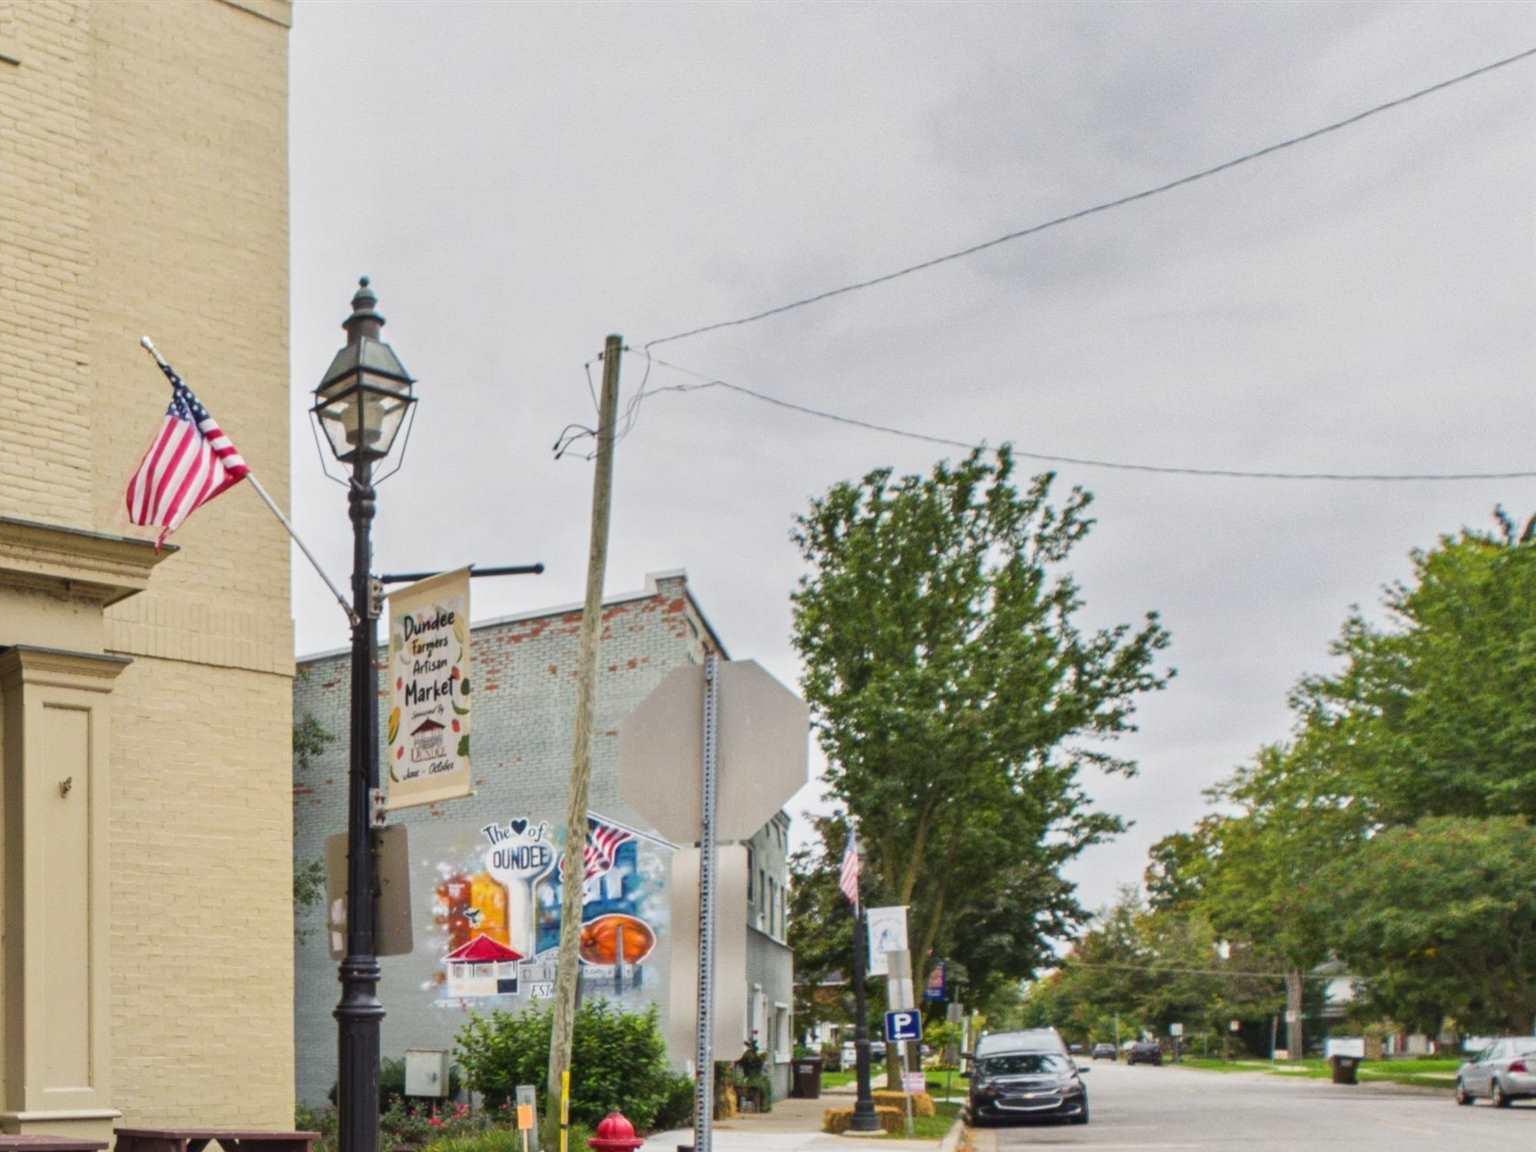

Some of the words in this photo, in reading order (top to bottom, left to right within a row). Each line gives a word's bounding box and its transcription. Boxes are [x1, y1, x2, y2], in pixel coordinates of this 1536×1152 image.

[404, 611, 454, 642] Dundee
[412, 636, 449, 656] Farmers
[413, 659, 447, 676] Artisan
[405, 674, 456, 706] Market
[483, 825, 511, 845] The
[528, 822, 547, 842] of
[493, 844, 548, 870] DUNDEE
[894, 1013, 912, 1034] P
